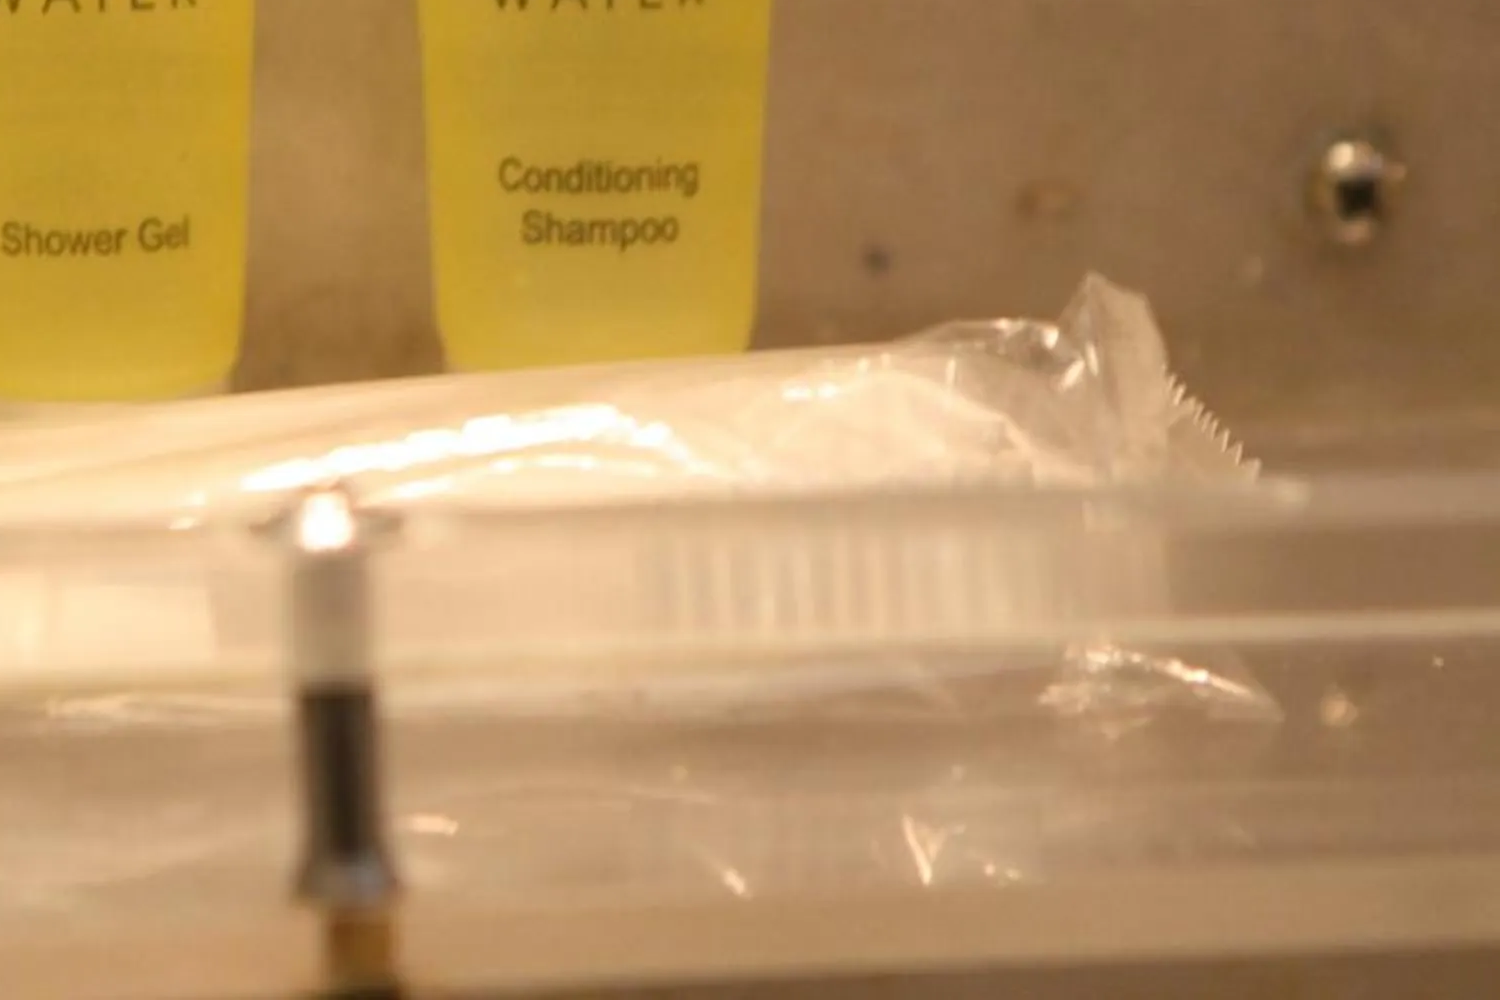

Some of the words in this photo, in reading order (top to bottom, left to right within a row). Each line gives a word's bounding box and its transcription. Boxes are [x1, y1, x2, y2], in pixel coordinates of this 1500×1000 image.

[497, 155, 700, 199] Conditioning
[0, 219, 131, 257] Shower
[136, 216, 190, 254] Gel
[521, 208, 681, 252] Shampoo
